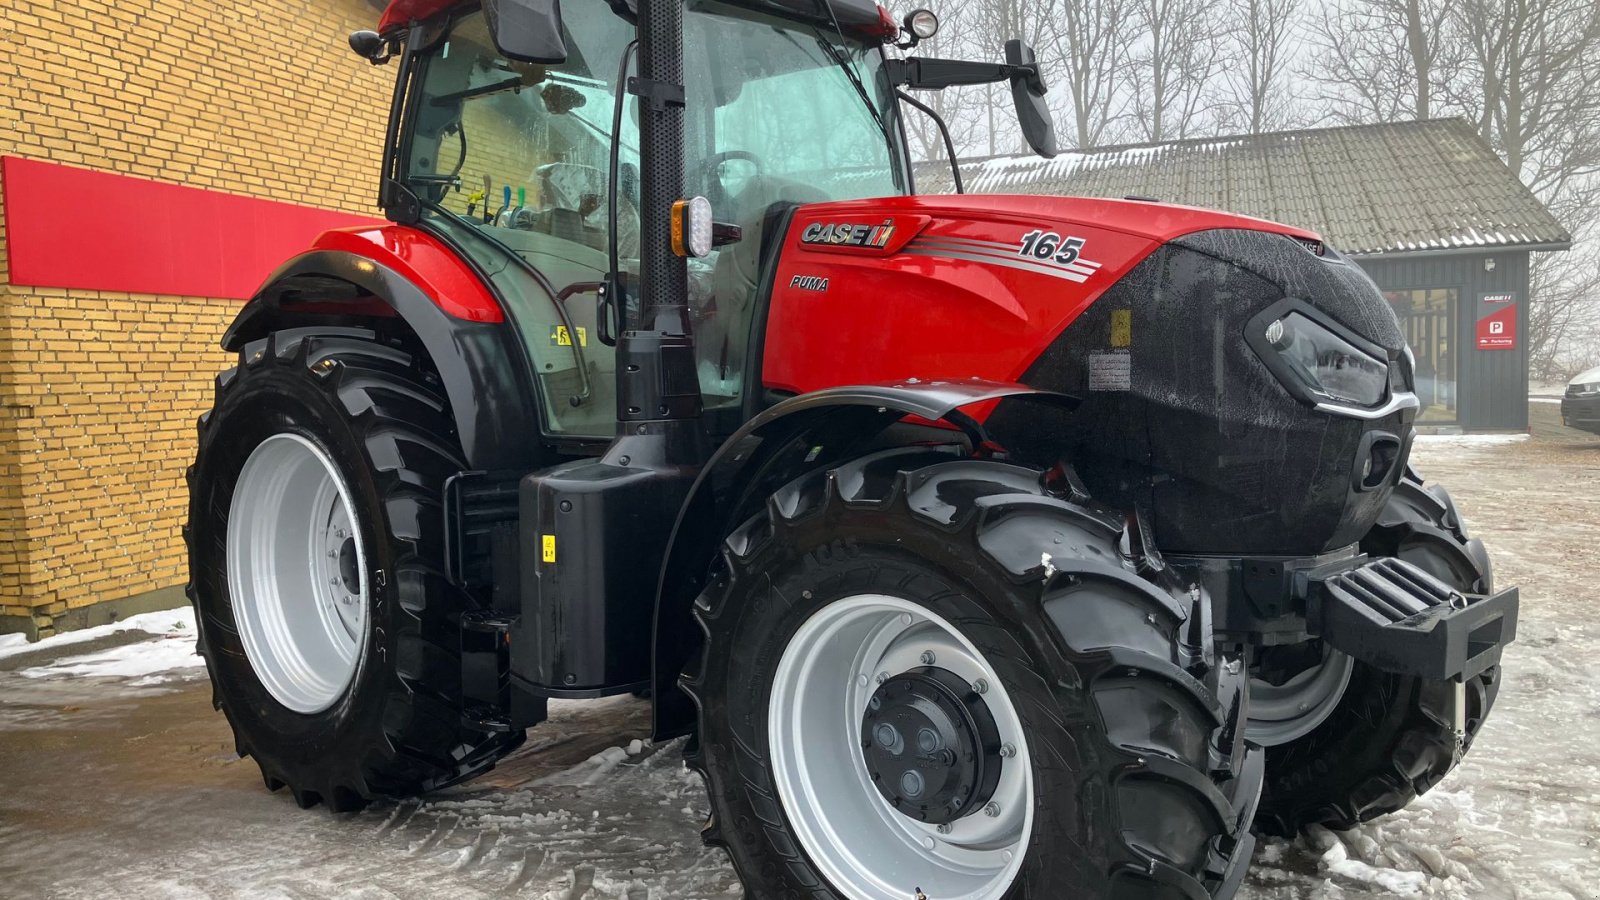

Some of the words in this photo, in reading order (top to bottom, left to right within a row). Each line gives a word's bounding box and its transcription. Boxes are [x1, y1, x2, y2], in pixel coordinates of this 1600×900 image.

[801, 222, 868, 244] CASE
[1019, 230, 1086, 264] 165
[789, 275, 829, 291] PUMA
